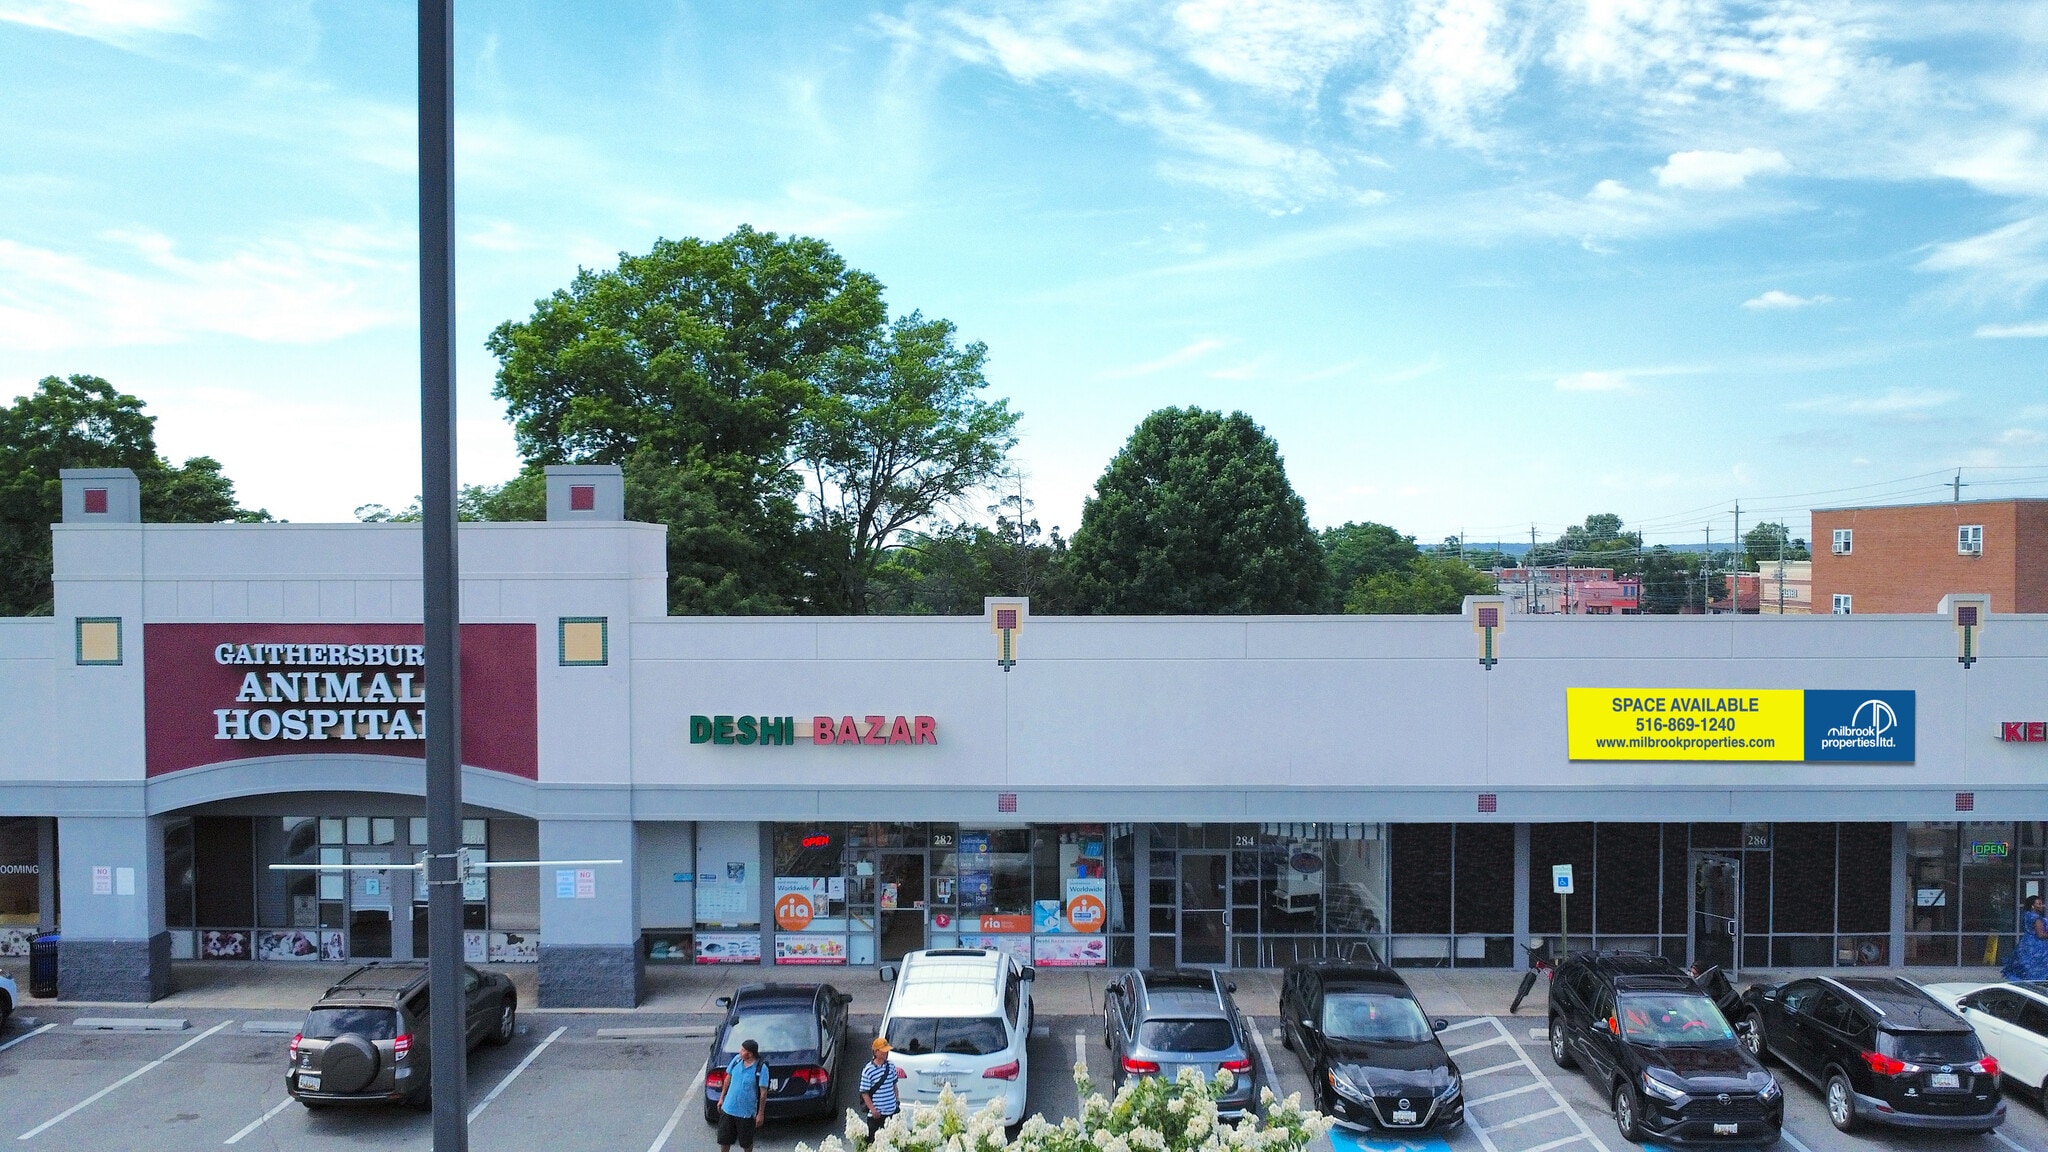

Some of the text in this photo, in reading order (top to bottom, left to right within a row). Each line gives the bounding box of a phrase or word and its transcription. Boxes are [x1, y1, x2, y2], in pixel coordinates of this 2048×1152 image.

[214, 643, 425, 666] GAITHERSBUR
[235, 671, 425, 703] ANIMAL
[1612, 697, 1759, 712] SPACE AVAILABLE
[690, 715, 938, 746] DESHI BAZAR
[1635, 717, 1736, 732] 516-869-1240
[1827, 726, 1875, 736] milbrook
[1596, 735, 1775, 750] www.milbrookproperties.com
[1821, 737, 1896, 750] properties ltd.
[801, 835, 830, 848] OPEN
[934, 835, 952, 845] 282
[1235, 835, 1254, 846] 284
[1748, 835, 1766, 846] 286
[1975, 844, 2005, 855] OPEN
[0, 864, 39, 874] OOMING
[779, 897, 809, 918] ria
[983, 917, 1001, 929] ria
